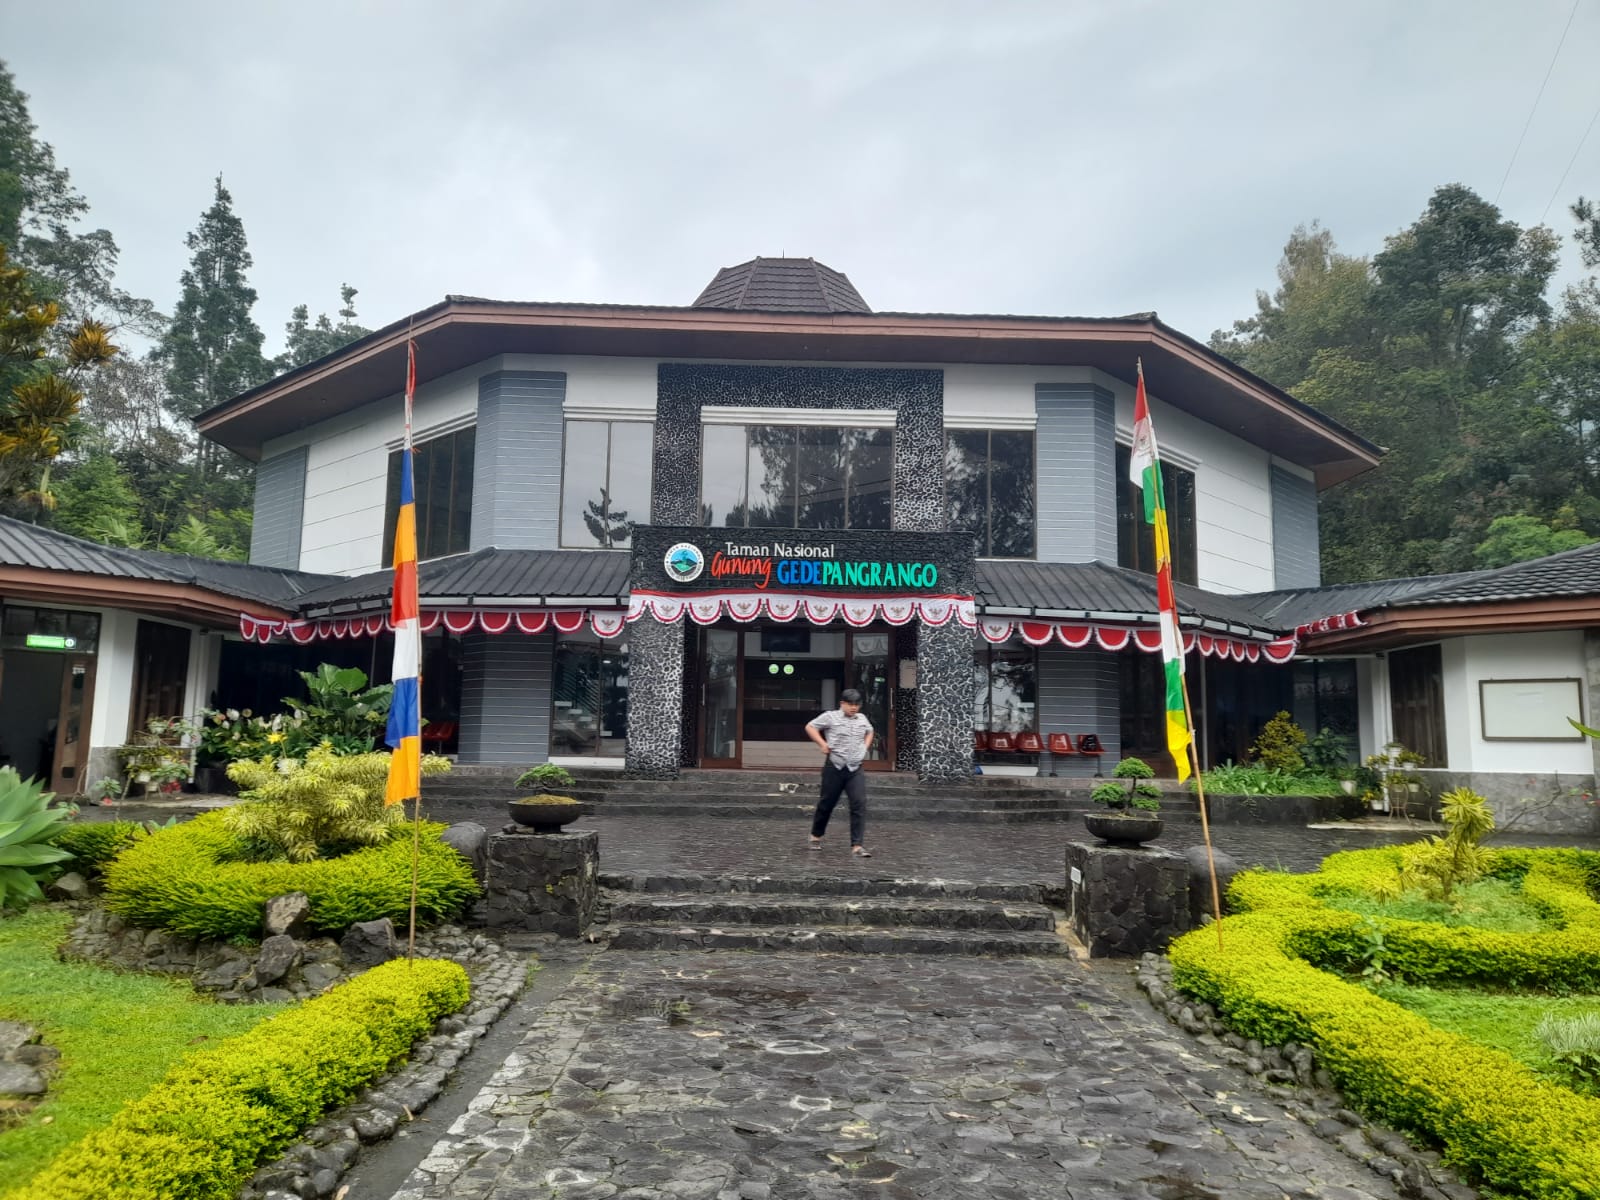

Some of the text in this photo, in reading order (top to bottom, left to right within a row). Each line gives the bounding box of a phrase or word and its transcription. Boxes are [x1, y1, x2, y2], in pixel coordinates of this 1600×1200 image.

[725, 541, 834, 558] Taman Nasional
[711, 551, 772, 590] Gunung
